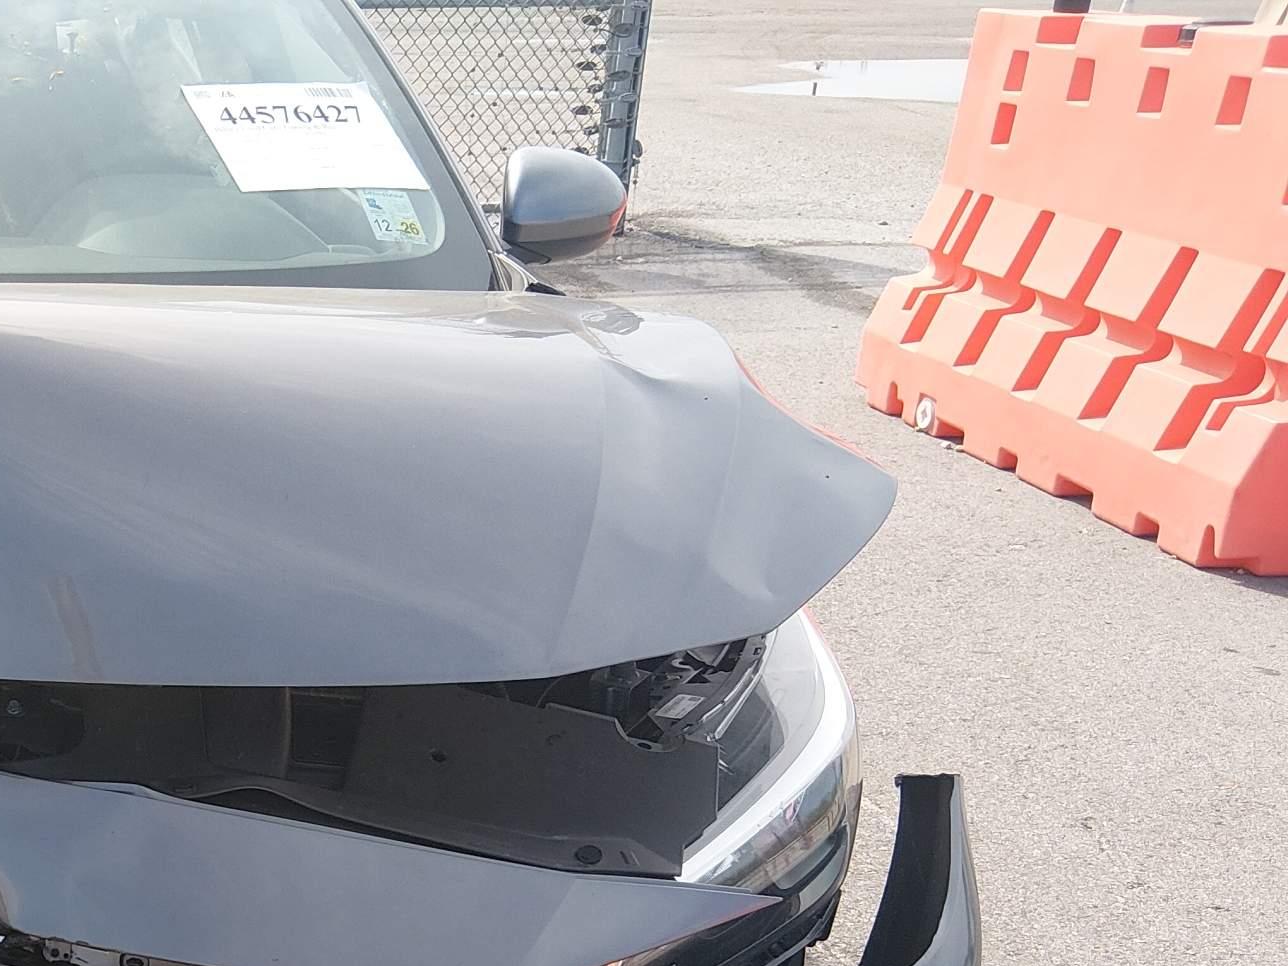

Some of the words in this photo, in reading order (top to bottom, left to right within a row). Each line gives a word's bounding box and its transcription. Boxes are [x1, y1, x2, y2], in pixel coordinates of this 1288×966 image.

[219, 104, 361, 125] 44576427
[374, 218, 393, 232] 12
[400, 221, 420, 236] 26
